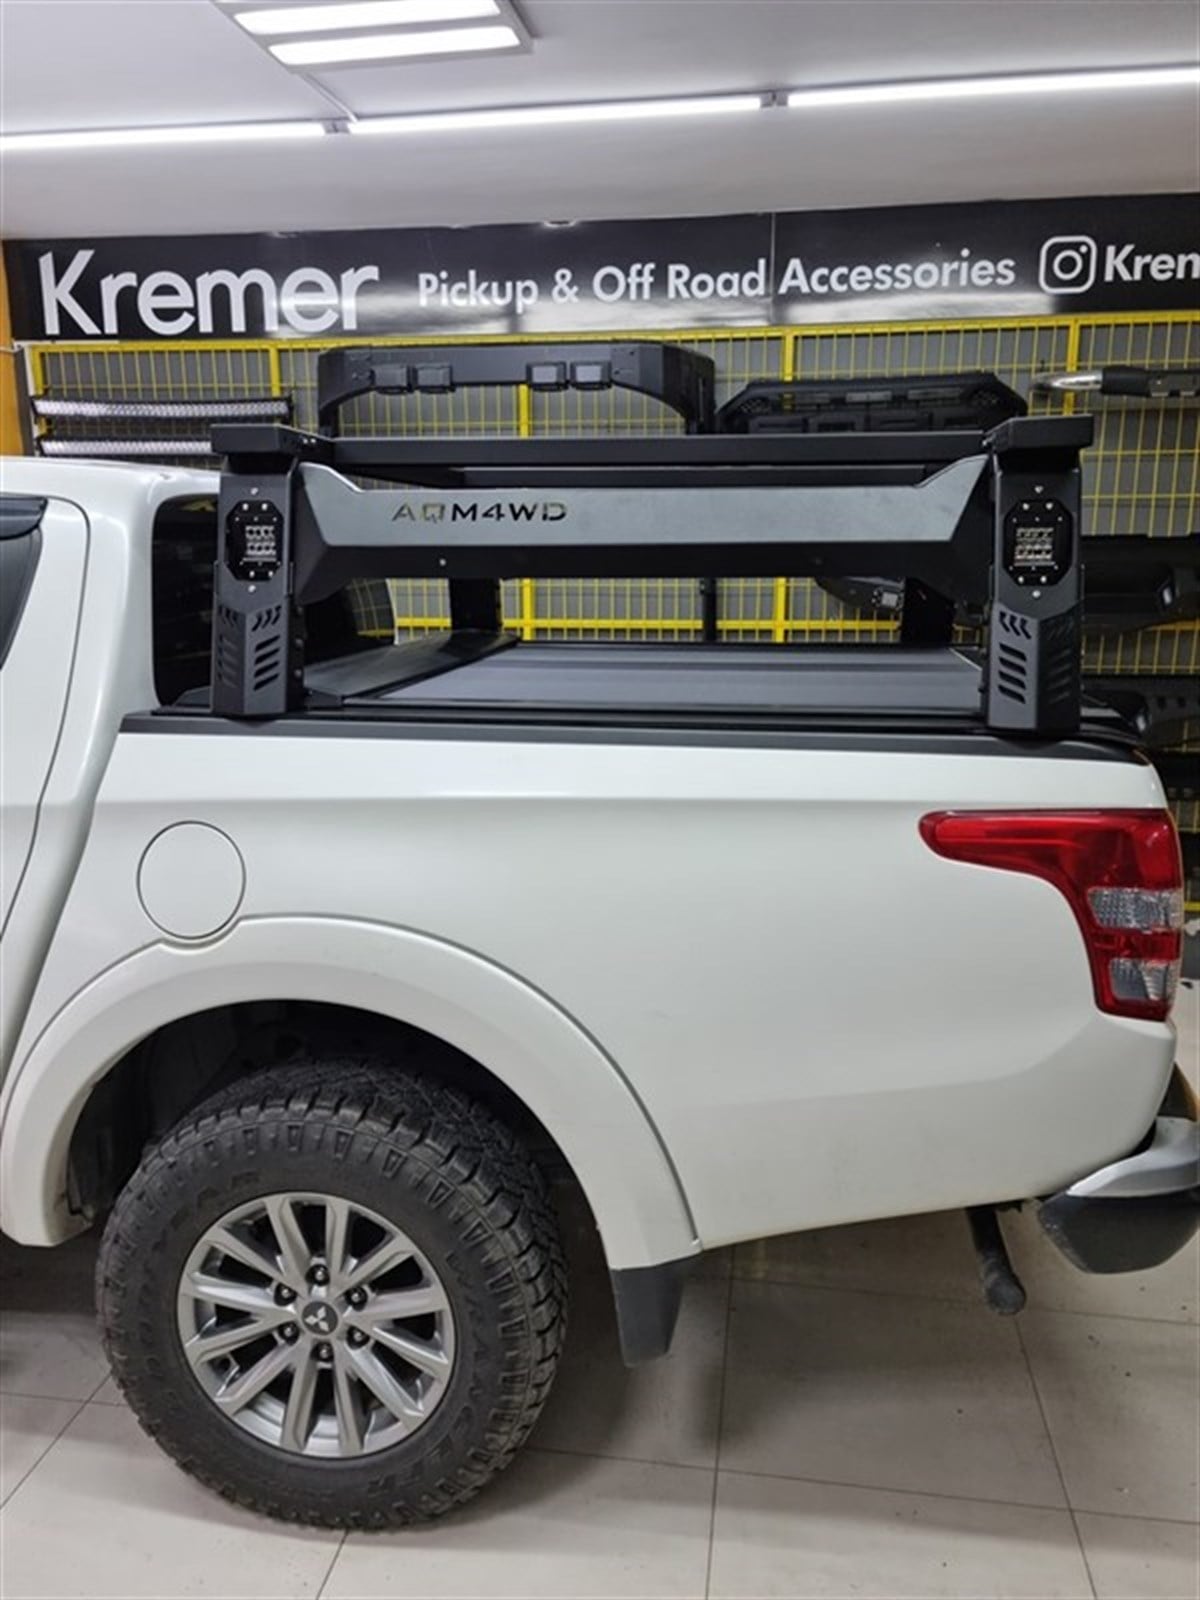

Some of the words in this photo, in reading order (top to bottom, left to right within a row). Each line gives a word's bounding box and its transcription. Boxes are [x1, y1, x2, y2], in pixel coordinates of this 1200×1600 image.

[38, 249, 380, 336] Kremer
[418, 269, 539, 315] Pickup
[551, 268, 580, 304] &
[592, 262, 656, 302] Off
[667, 258, 767, 300] Road
[778, 247, 1016, 295] Accessories
